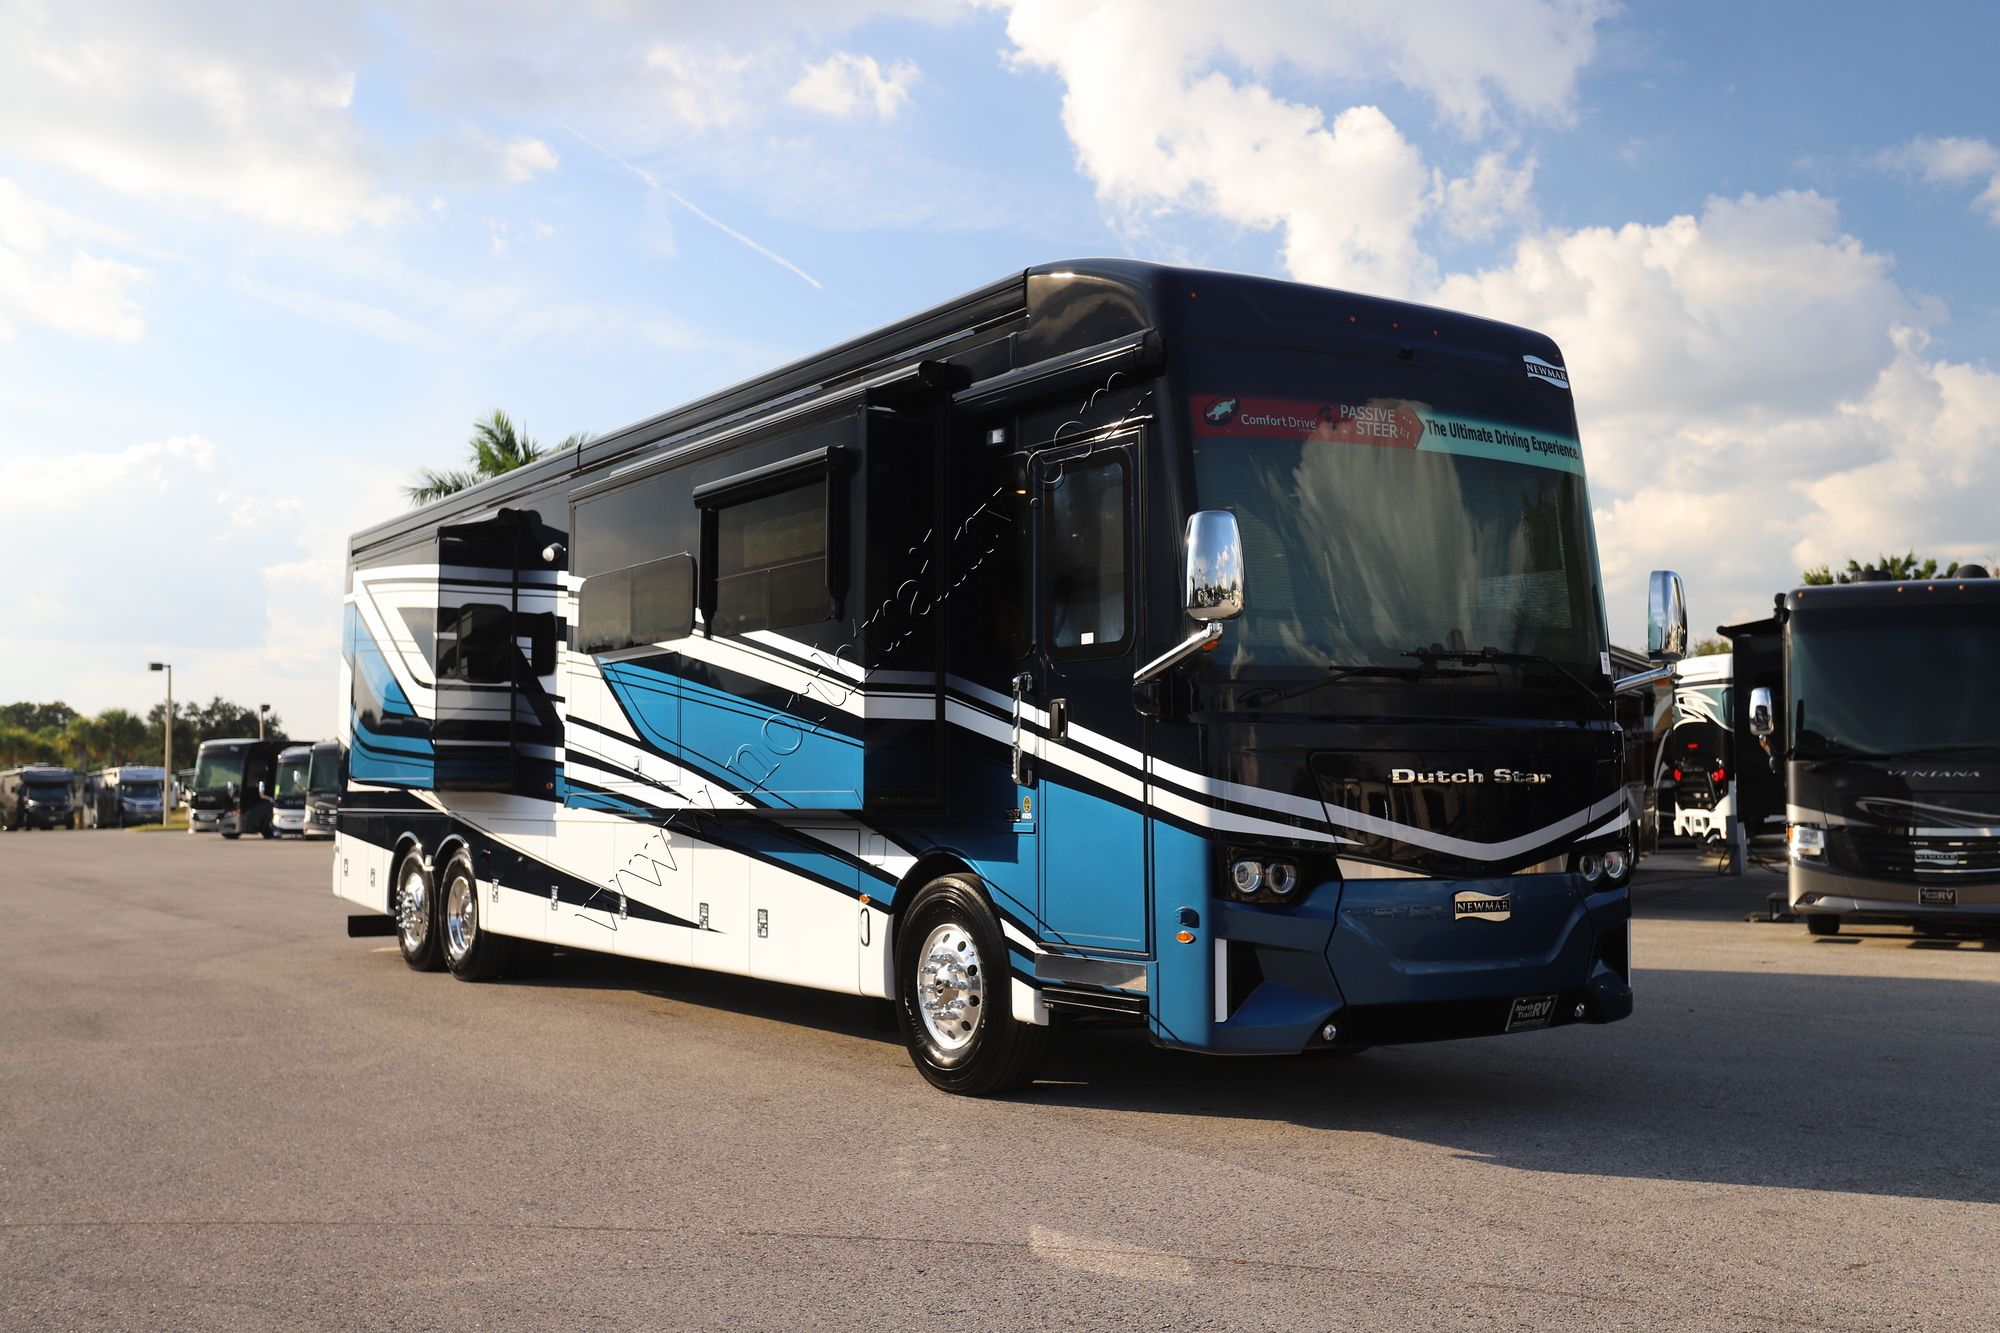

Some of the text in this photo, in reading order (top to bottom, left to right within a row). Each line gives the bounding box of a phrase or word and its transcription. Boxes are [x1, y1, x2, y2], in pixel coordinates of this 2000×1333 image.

[1525, 362, 1568, 381] NEWMAR
[1240, 414, 1317, 429] Comfort Drive
[1340, 404, 1396, 423] PASSIVE
[1356, 421, 1398, 438] STEER
[1425, 419, 1447, 437] The
[1448, 422, 1493, 444] Ultimate
[1494, 429, 1530, 453] Driving
[1391, 768, 1552, 784] Dutch Star
[1457, 901, 1509, 912] NEWMAR
[1531, 1001, 1552, 1017] RV
